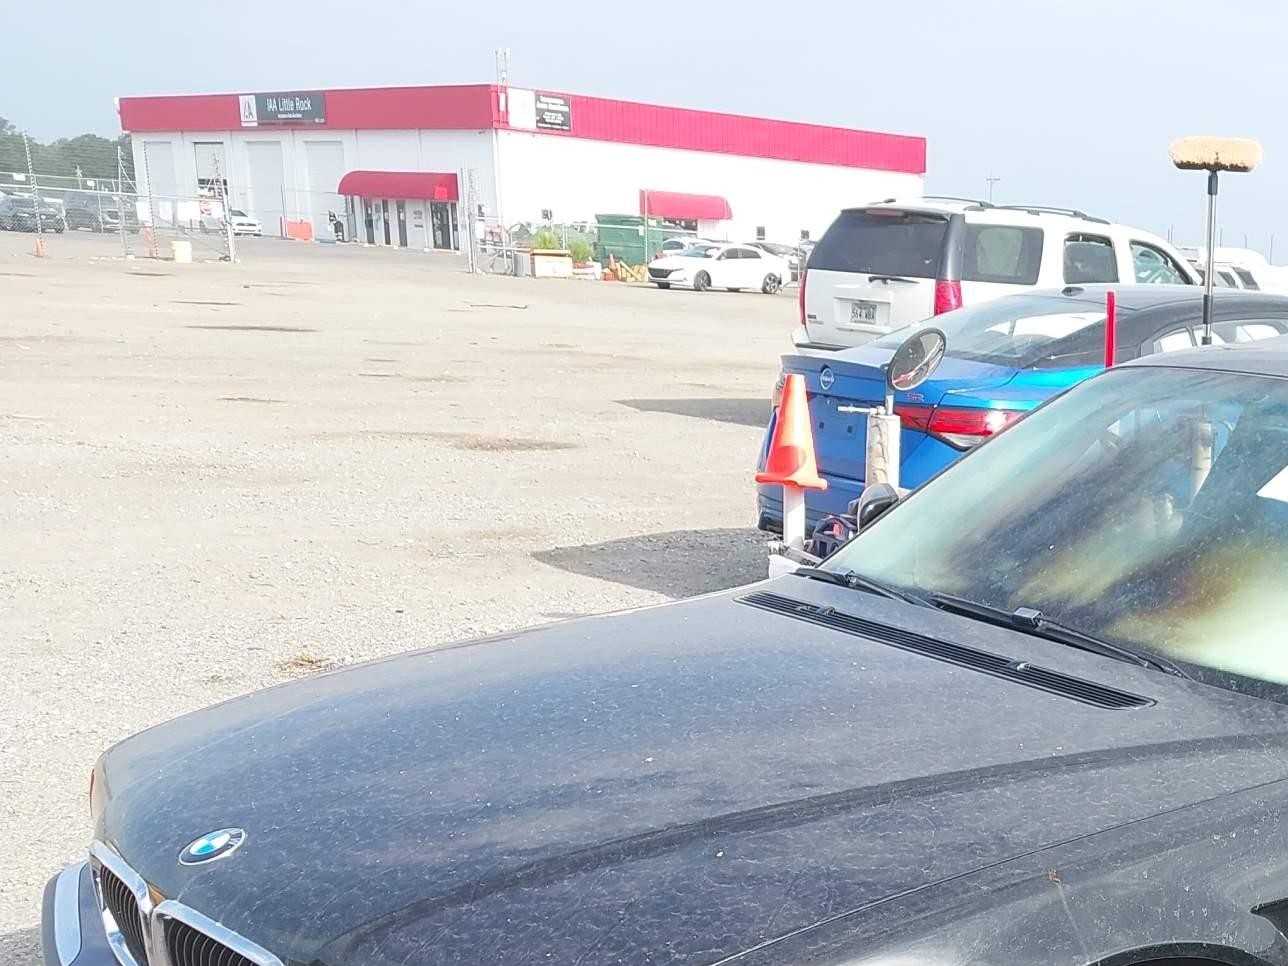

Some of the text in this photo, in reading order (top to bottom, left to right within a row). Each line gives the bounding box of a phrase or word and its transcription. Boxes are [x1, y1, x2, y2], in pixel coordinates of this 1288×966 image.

[266, 98, 278, 112] IAA
[278, 97, 295, 112] Little
[295, 96, 312, 111] Rock
